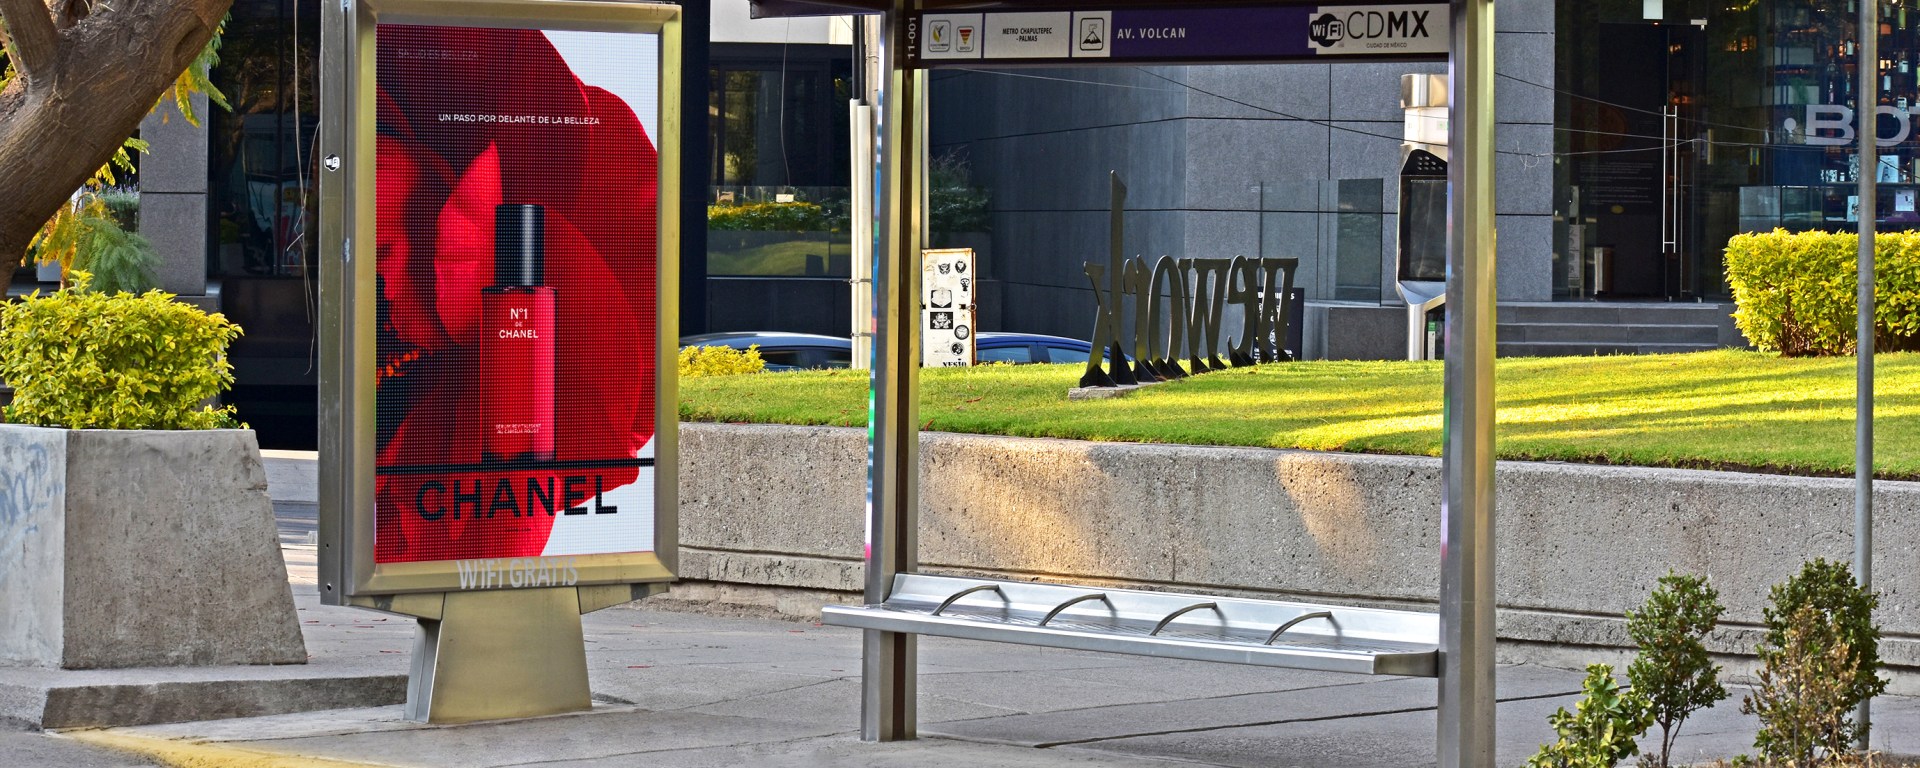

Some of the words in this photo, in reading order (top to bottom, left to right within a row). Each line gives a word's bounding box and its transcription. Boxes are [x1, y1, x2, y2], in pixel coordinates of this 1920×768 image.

[1020, 27, 1053, 35] CHAPULTEPEC
[1346, 10, 1430, 40] CDMX
[908, 17, 917, 60] 11-001
[1117, 28, 1135, 39] AV.
[1139, 27, 1186, 39] VOLCAN
[438, 113, 452, 122] UN
[453, 114, 476, 122] PASO
[478, 115, 496, 123] POR
[498, 115, 536, 123] DELANTE
[538, 116, 550, 124] DE
[551, 116, 562, 124] LA
[564, 117, 600, 125] BELLEZA
[499, 329, 539, 339] CHANEL
[414, 475, 618, 522] CHANEL
